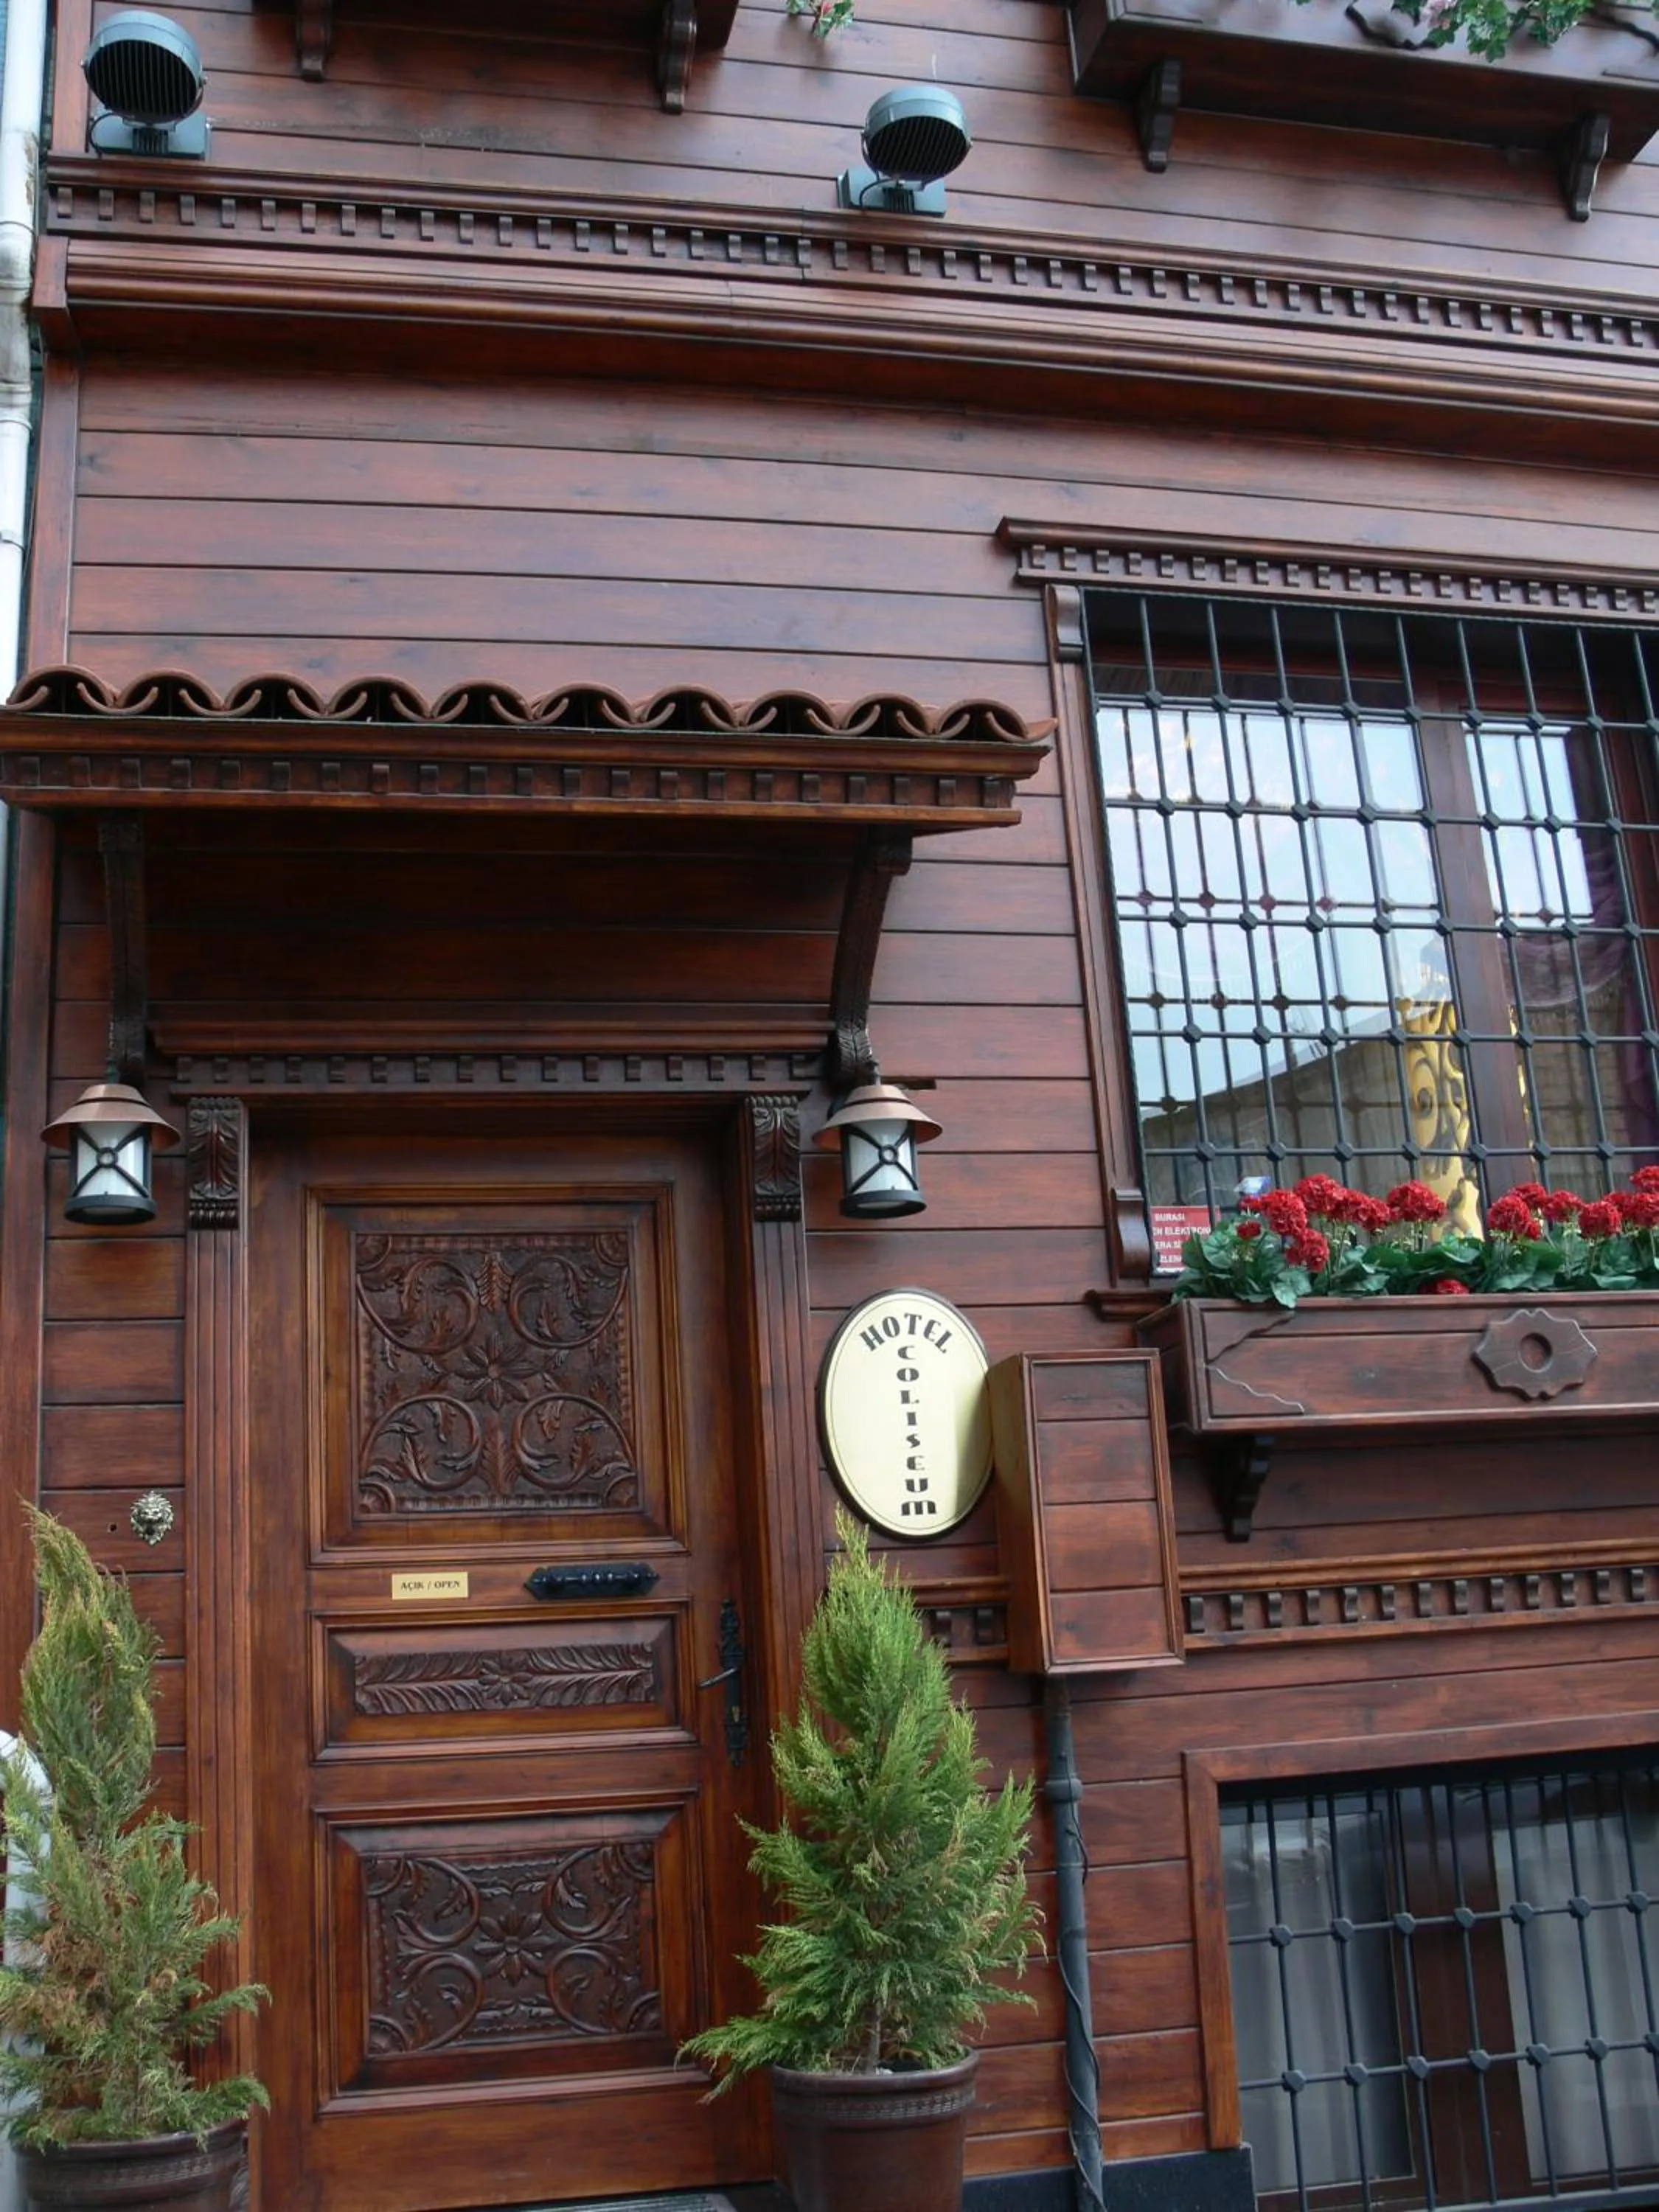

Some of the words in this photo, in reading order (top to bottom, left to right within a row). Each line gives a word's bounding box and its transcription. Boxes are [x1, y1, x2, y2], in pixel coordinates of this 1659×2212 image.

[1155, 1213, 1185, 1222] BURASI
[859, 1312, 953, 1354] HOTEL
[896, 1345, 936, 1516] COLISEUM
[401, 1581, 424, 1591] AÇIK
[434, 1580, 460, 1588] OPEN
